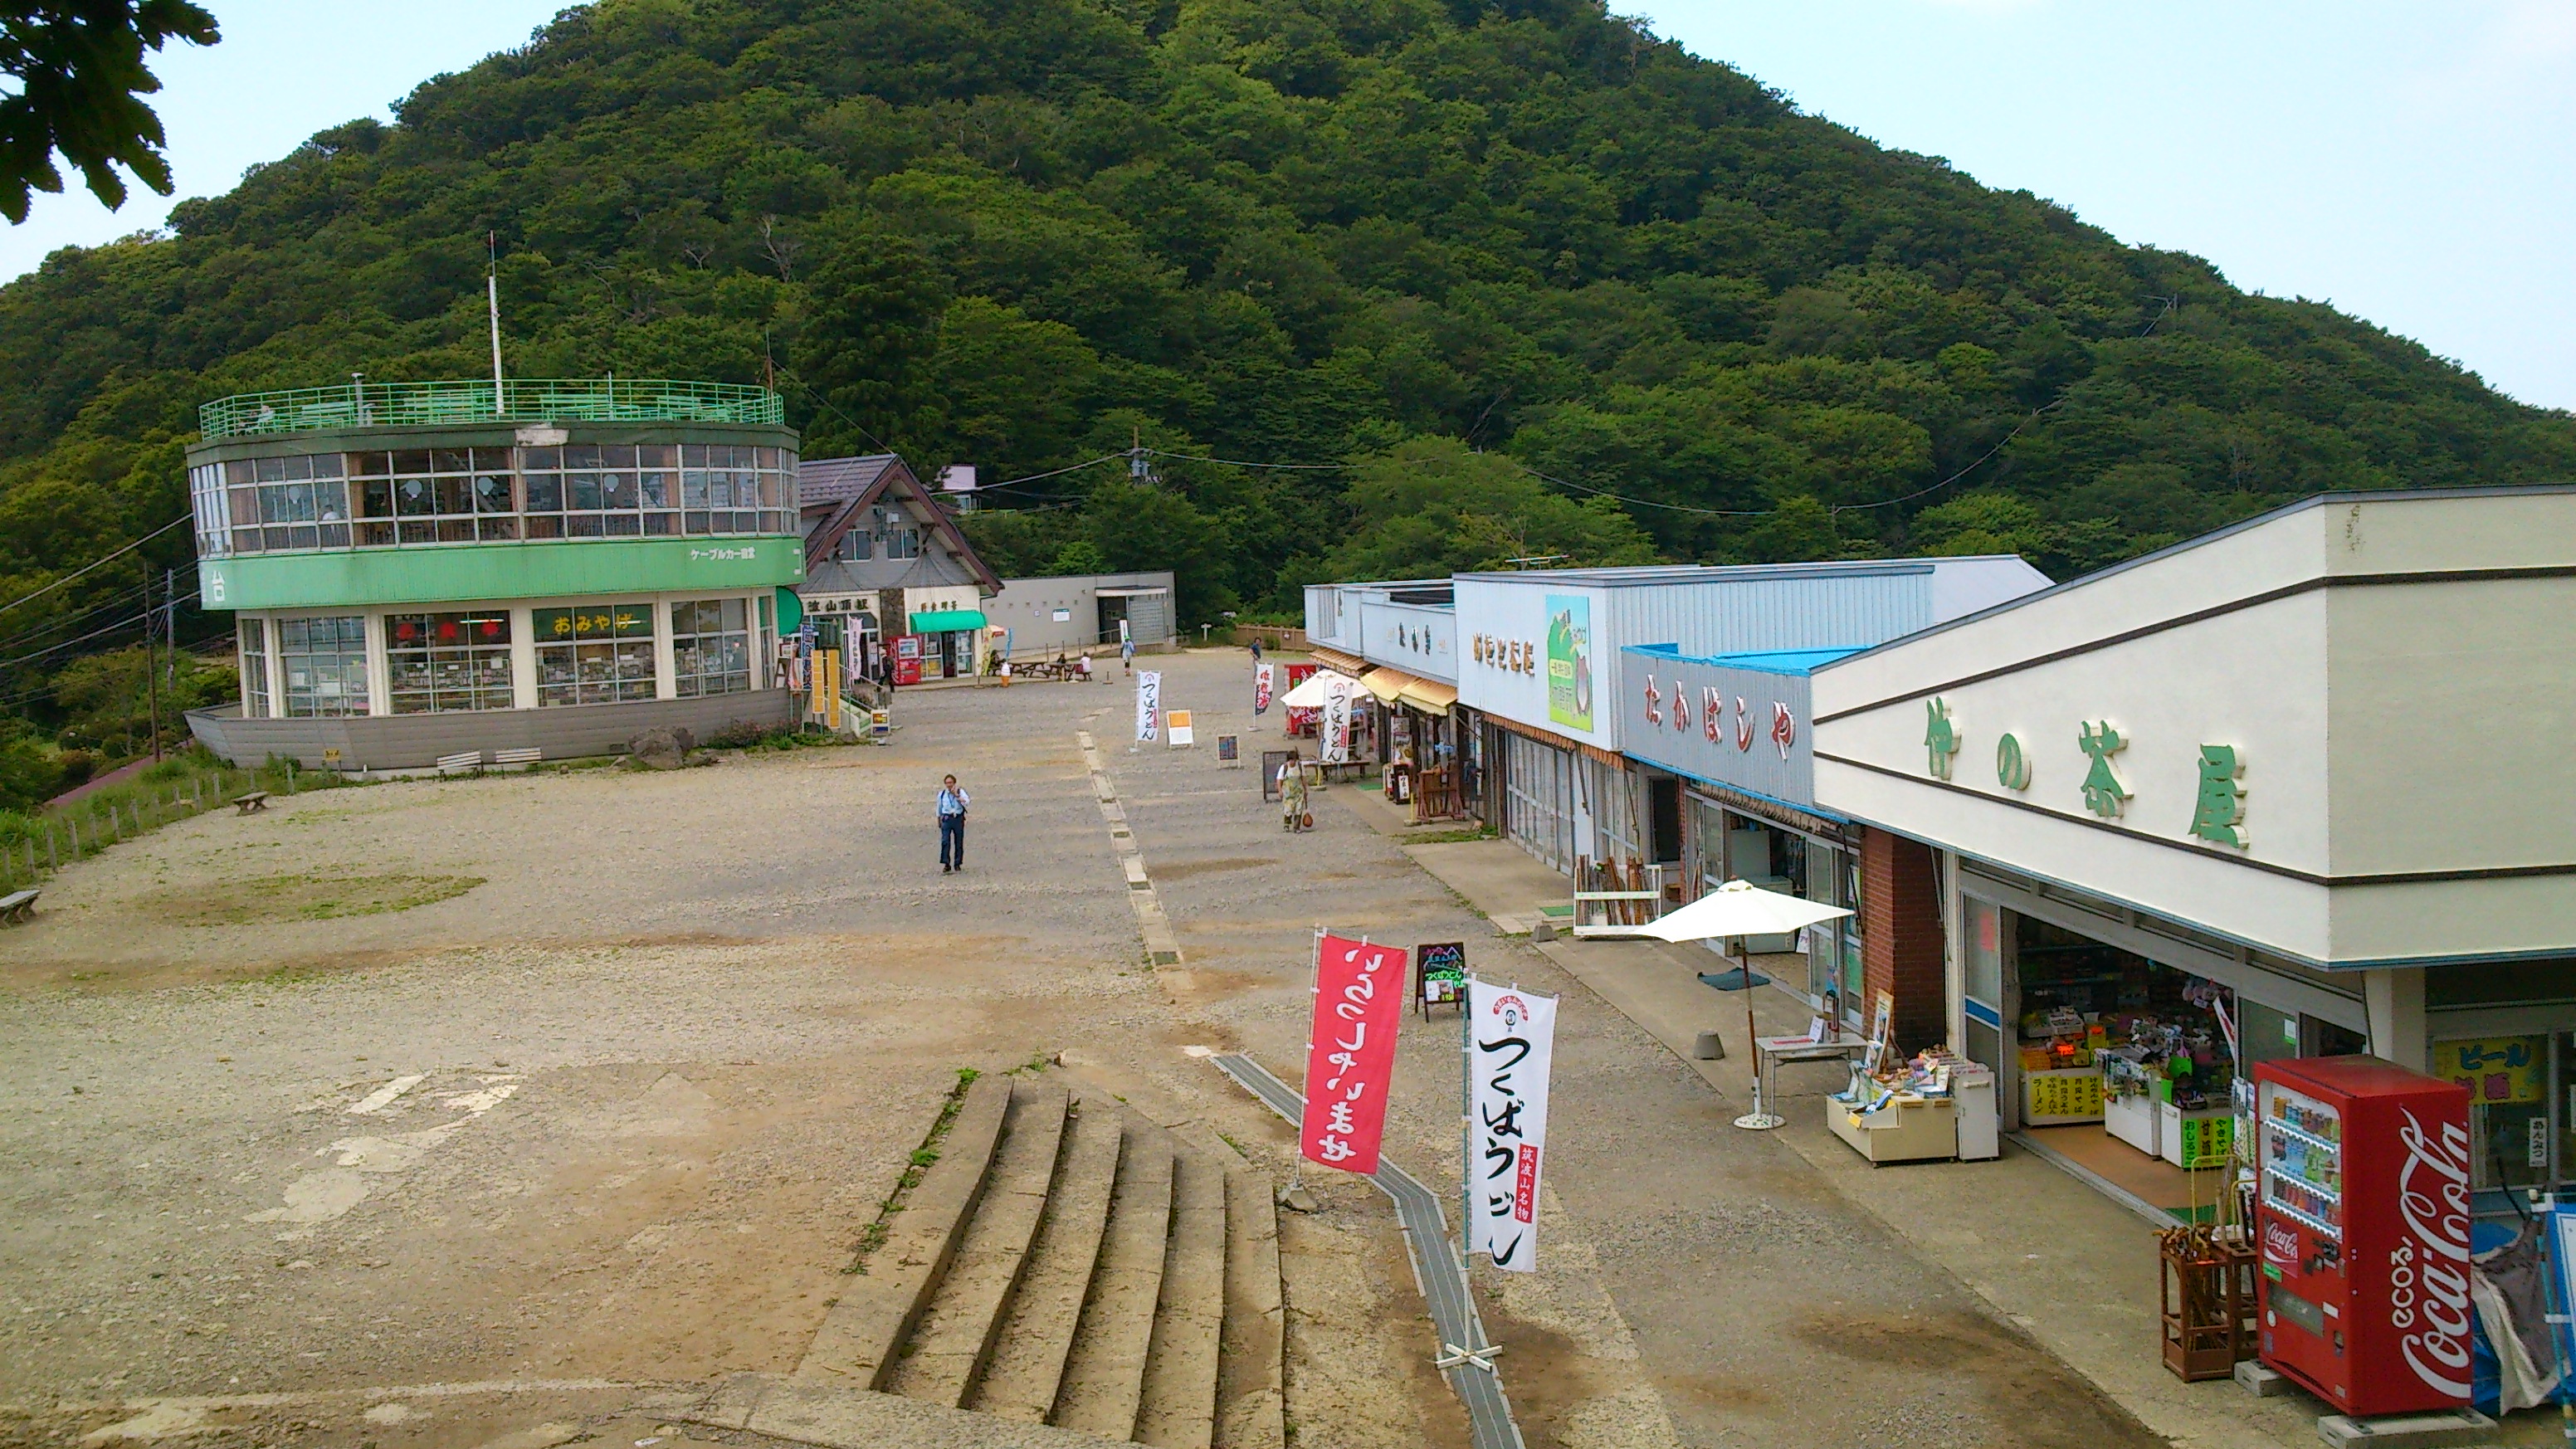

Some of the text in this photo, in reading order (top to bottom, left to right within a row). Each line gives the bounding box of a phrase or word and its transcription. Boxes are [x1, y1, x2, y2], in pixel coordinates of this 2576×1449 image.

[553, 612, 634, 635] おみやげ
[1141, 683, 1156, 740] つくばうどん
[1328, 694, 1345, 762] つくばうどん
[1645, 673, 1796, 761] たかはしや
[2458, 1043, 2531, 1071] ビール
[2033, 1079, 2043, 1114] ラーメン
[1516, 1146, 1534, 1221] 筑波山名物
